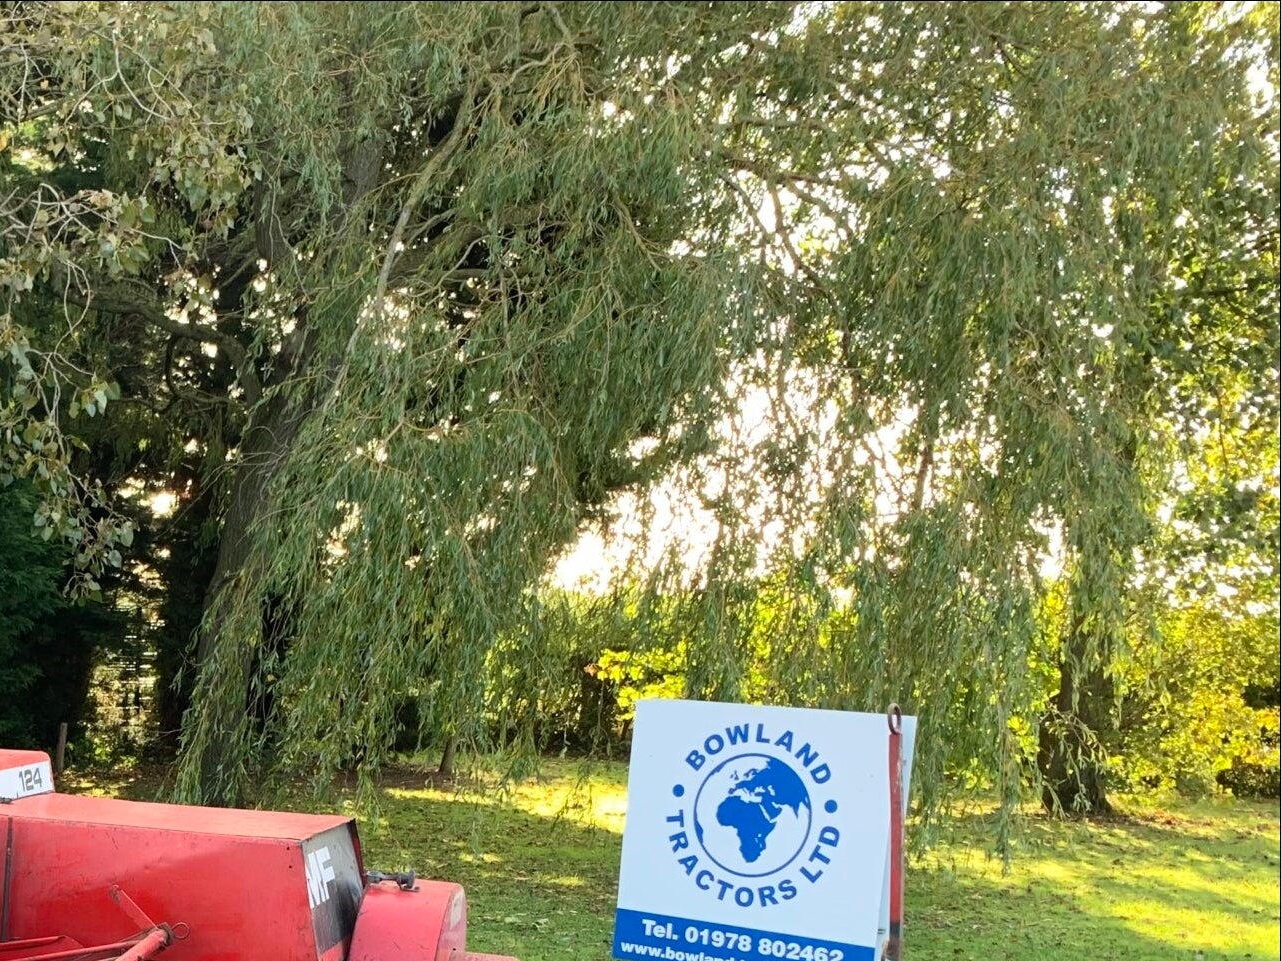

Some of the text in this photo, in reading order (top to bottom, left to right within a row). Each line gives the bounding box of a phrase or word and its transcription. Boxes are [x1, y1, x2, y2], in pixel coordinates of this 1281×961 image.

[19, 767, 42, 792] 124
[685, 723, 832, 785] BOWLAND
[305, 846, 336, 909] MF
[666, 809, 840, 908] TRACTORS LTD
[641, 918, 679, 941] Tel.
[684, 925, 752, 952] 01978
